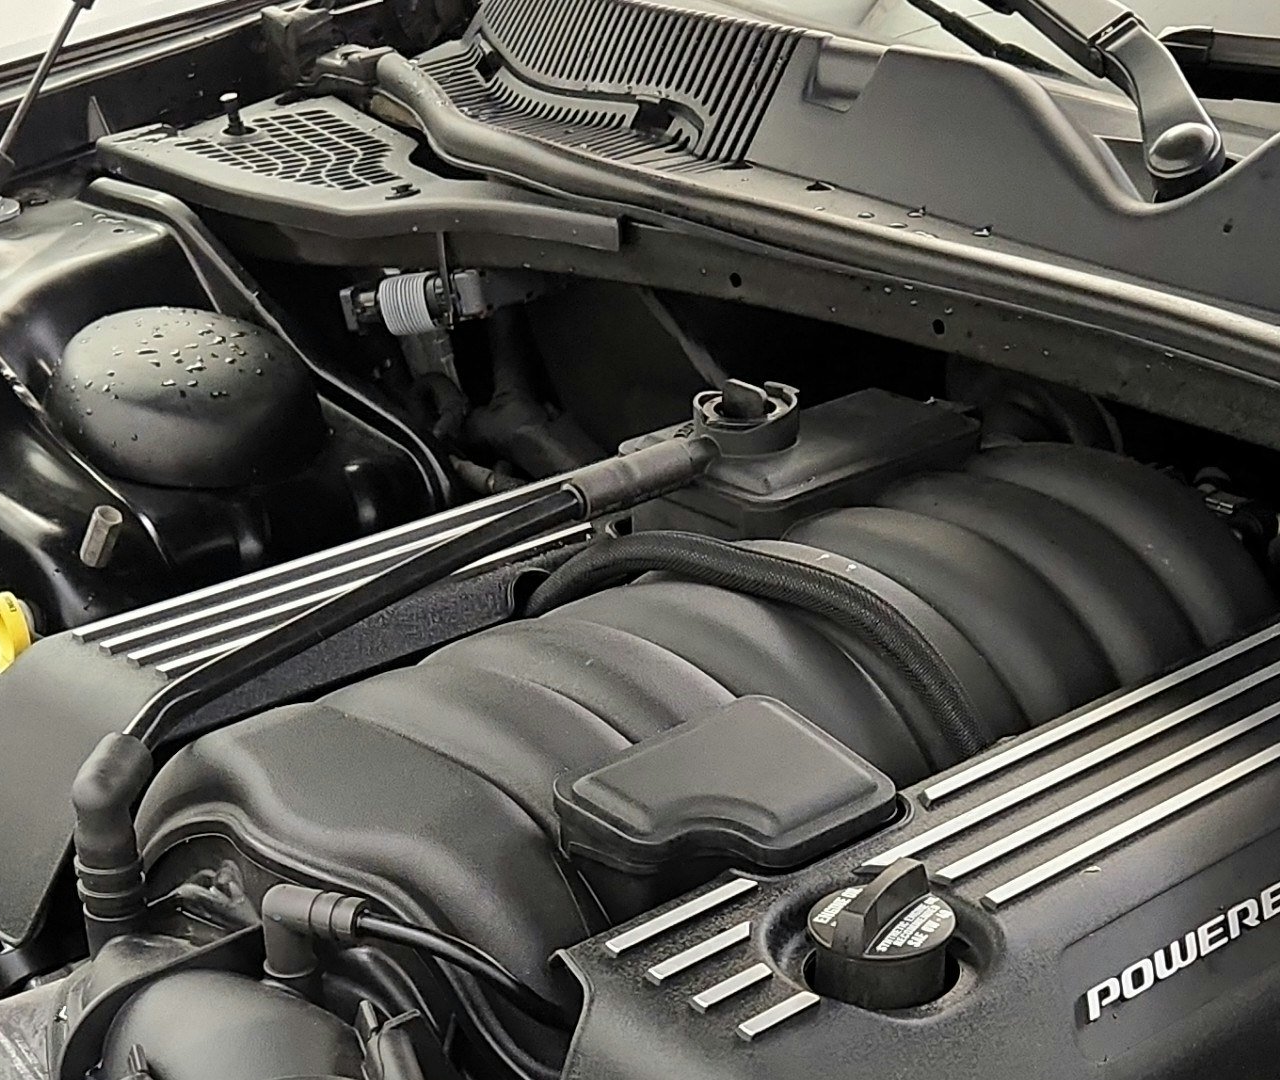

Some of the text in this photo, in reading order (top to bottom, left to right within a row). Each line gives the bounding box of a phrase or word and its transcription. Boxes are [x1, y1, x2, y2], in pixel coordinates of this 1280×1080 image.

[812, 887, 863, 924] ENGINE OIL
[907, 931, 928, 948] SAE
